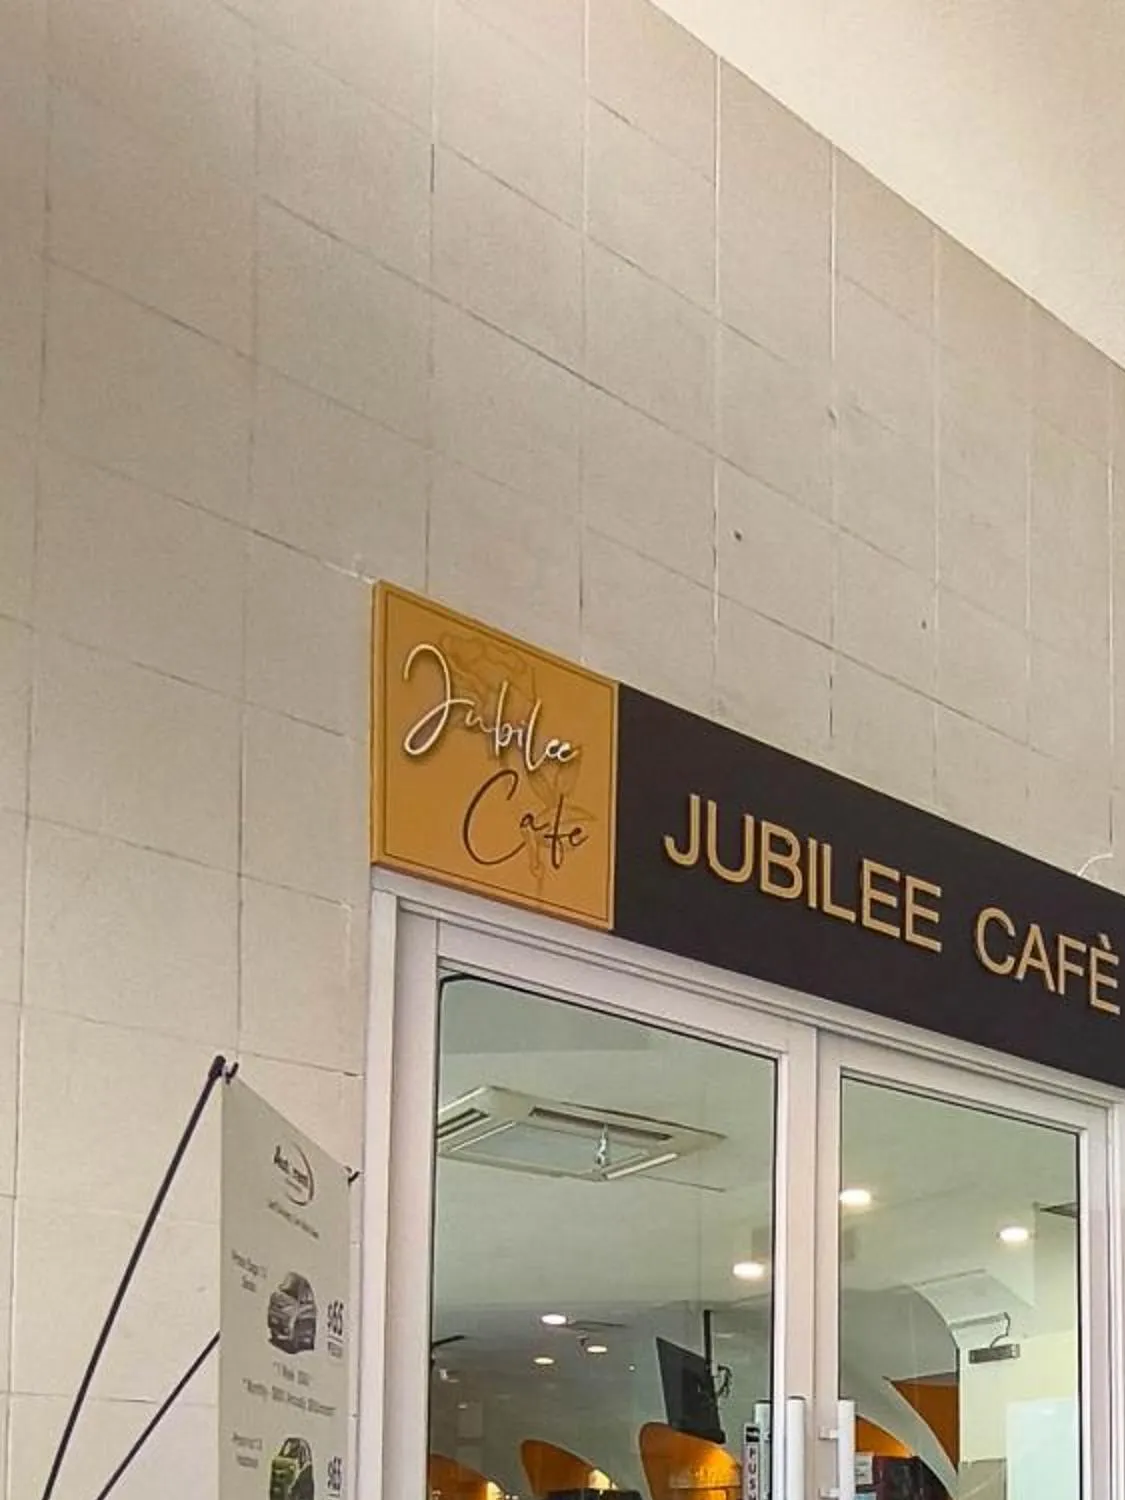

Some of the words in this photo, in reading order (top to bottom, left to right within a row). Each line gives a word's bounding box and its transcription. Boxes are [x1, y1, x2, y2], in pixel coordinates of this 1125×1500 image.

[403, 643, 579, 771] Jubilee
[463, 768, 589, 870] Cafe
[663, 793, 942, 953] JUBILEE
[975, 906, 1121, 1016] CAFÈ
